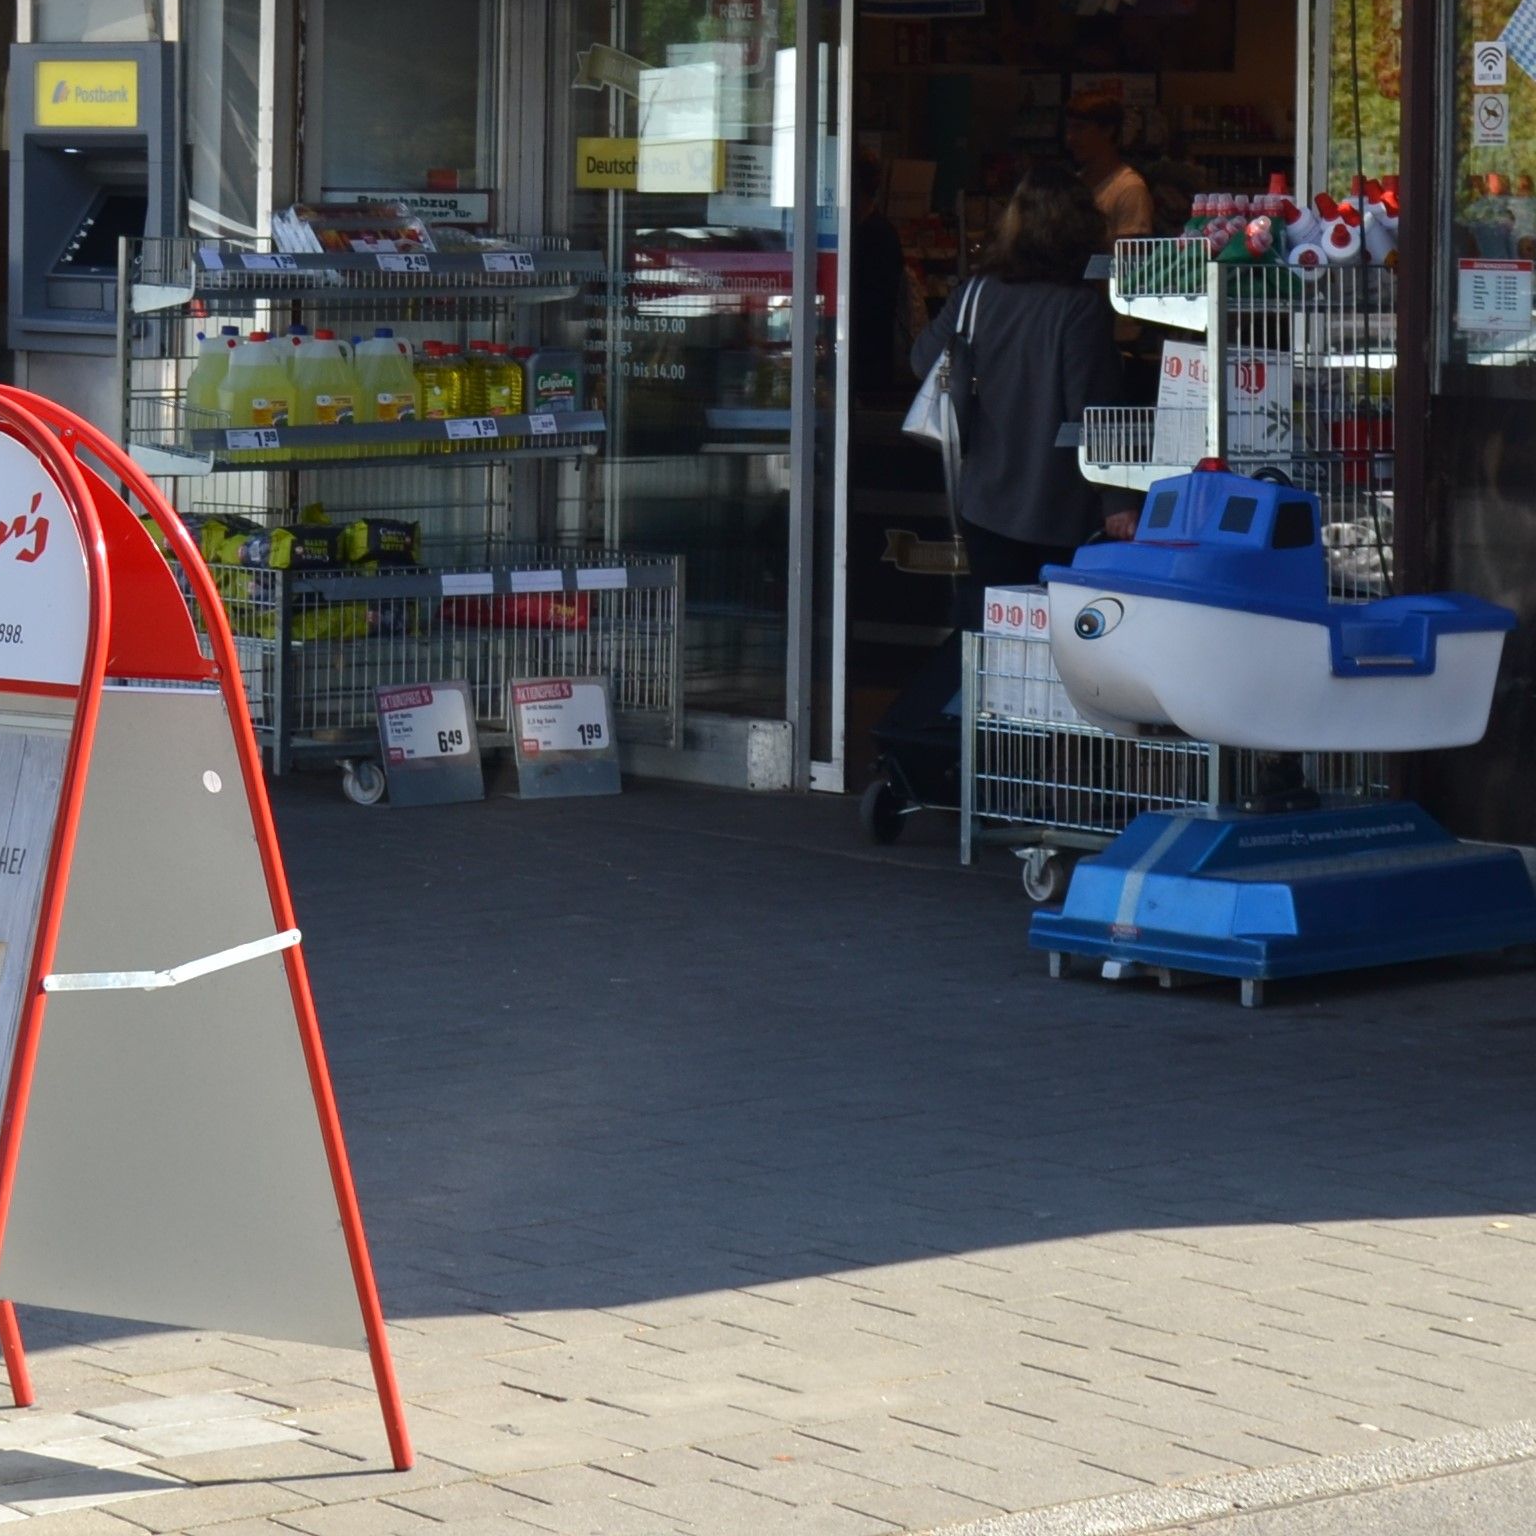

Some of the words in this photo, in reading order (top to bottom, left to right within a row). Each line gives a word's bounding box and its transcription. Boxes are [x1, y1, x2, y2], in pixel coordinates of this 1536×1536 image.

[74, 85, 129, 104] Postbank
[404, 255, 428, 271] 2.49
[509, 254, 532, 270] 1.49
[633, 317, 650, 332] bis
[653, 317, 686, 333] 19.00
[633, 362, 650, 377] bis
[652, 362, 686, 380] 14.00
[437, 729, 463, 753] 6.49
[577, 723, 603, 746] 1.99
